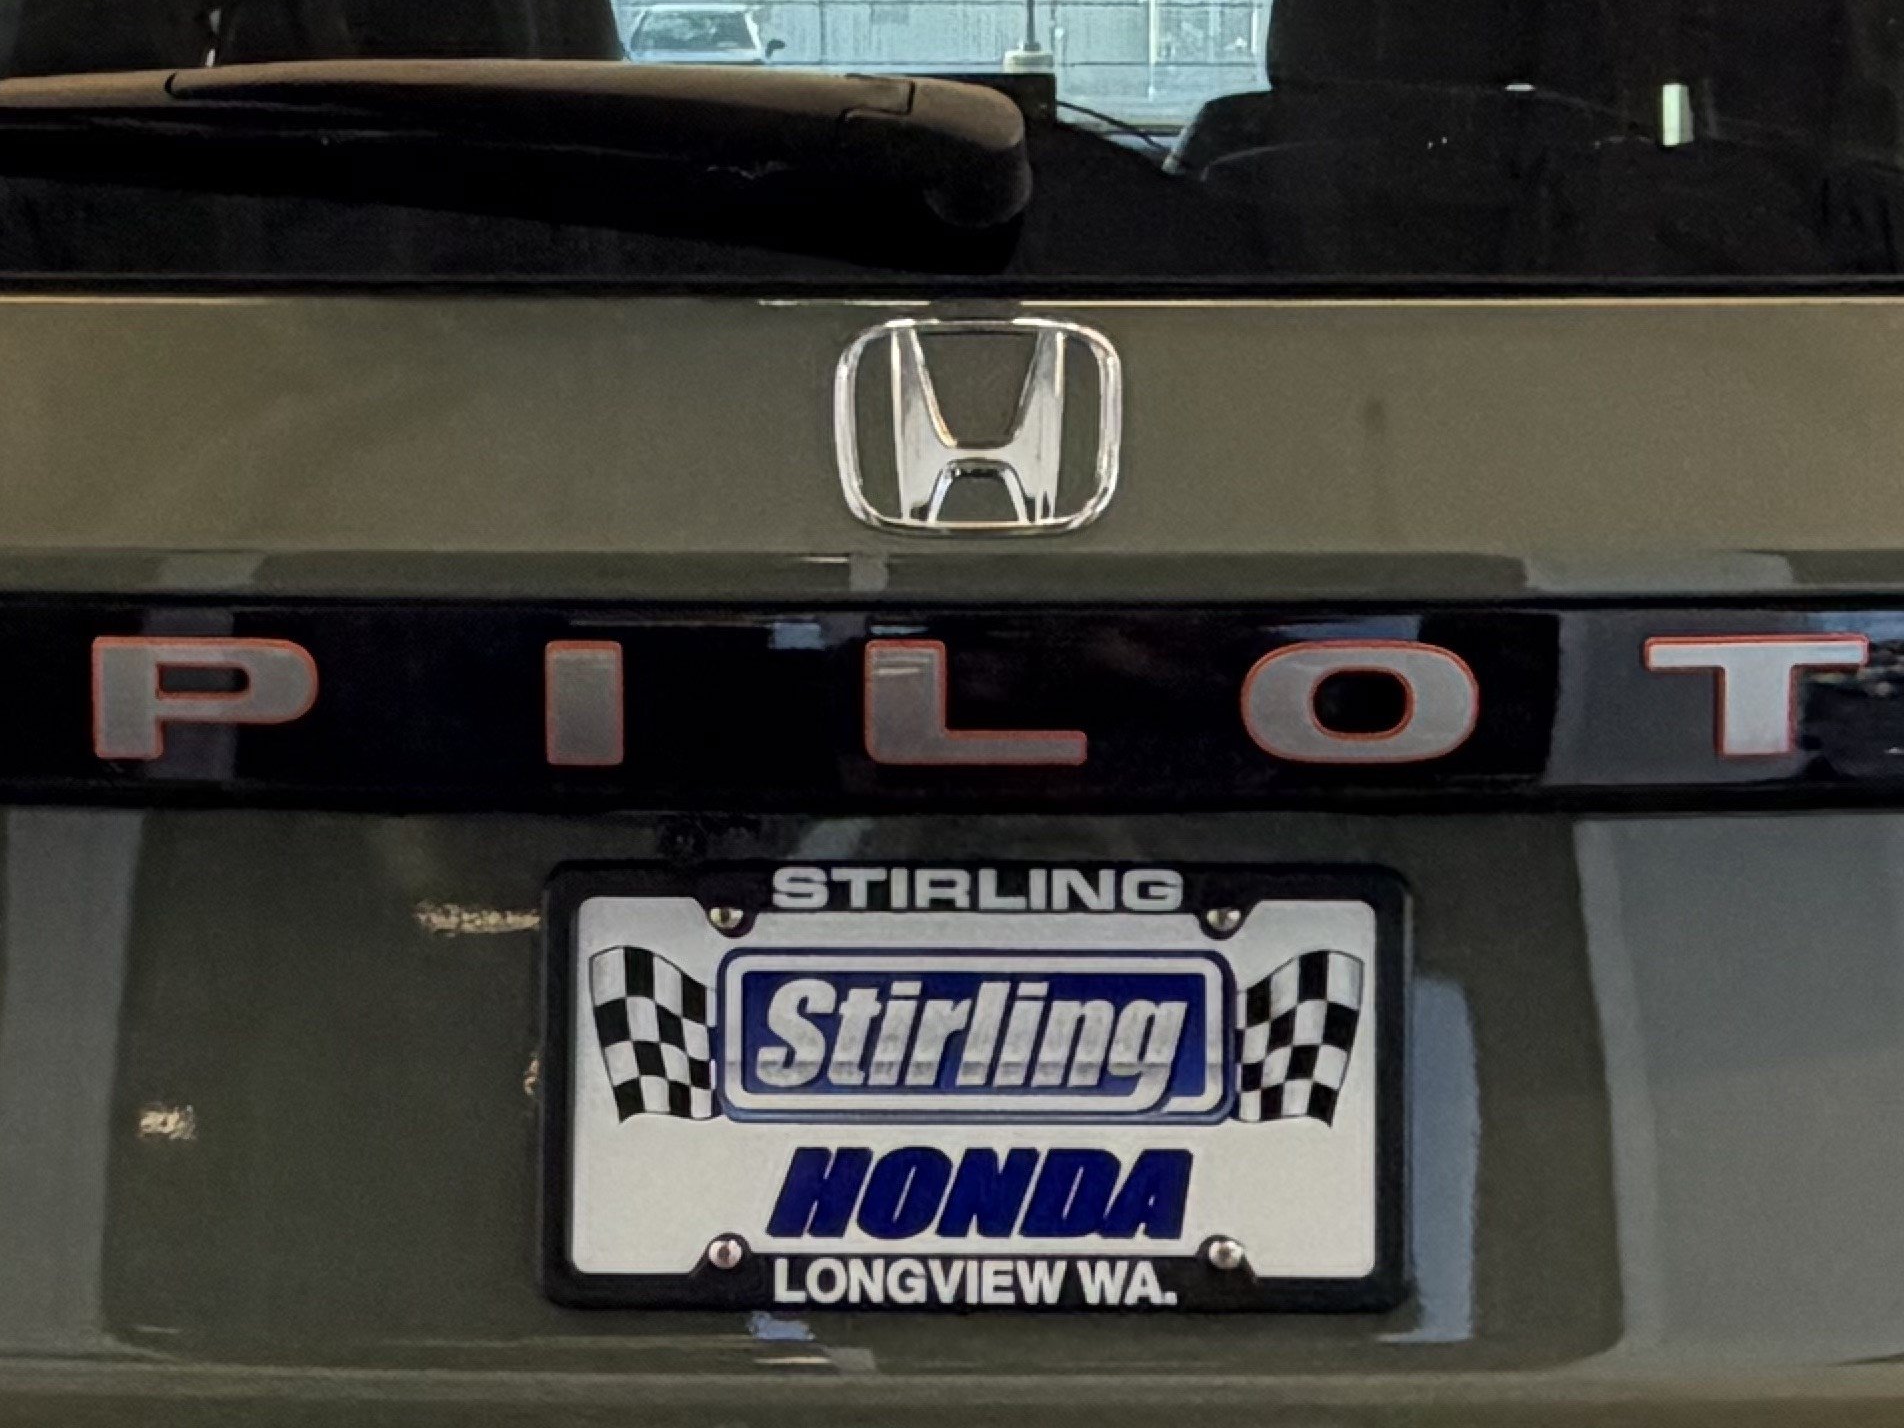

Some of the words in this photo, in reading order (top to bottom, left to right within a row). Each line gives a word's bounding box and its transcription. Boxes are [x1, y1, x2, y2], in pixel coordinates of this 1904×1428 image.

[93, 637, 1868, 766] PILOT
[772, 867, 1183, 911] STIRLING
[756, 978, 1187, 1109] Stirling
[766, 1146, 1193, 1239] HONDA
[774, 1258, 1067, 1305] LONGVIEW
[1077, 1258, 1178, 1305] WA.
